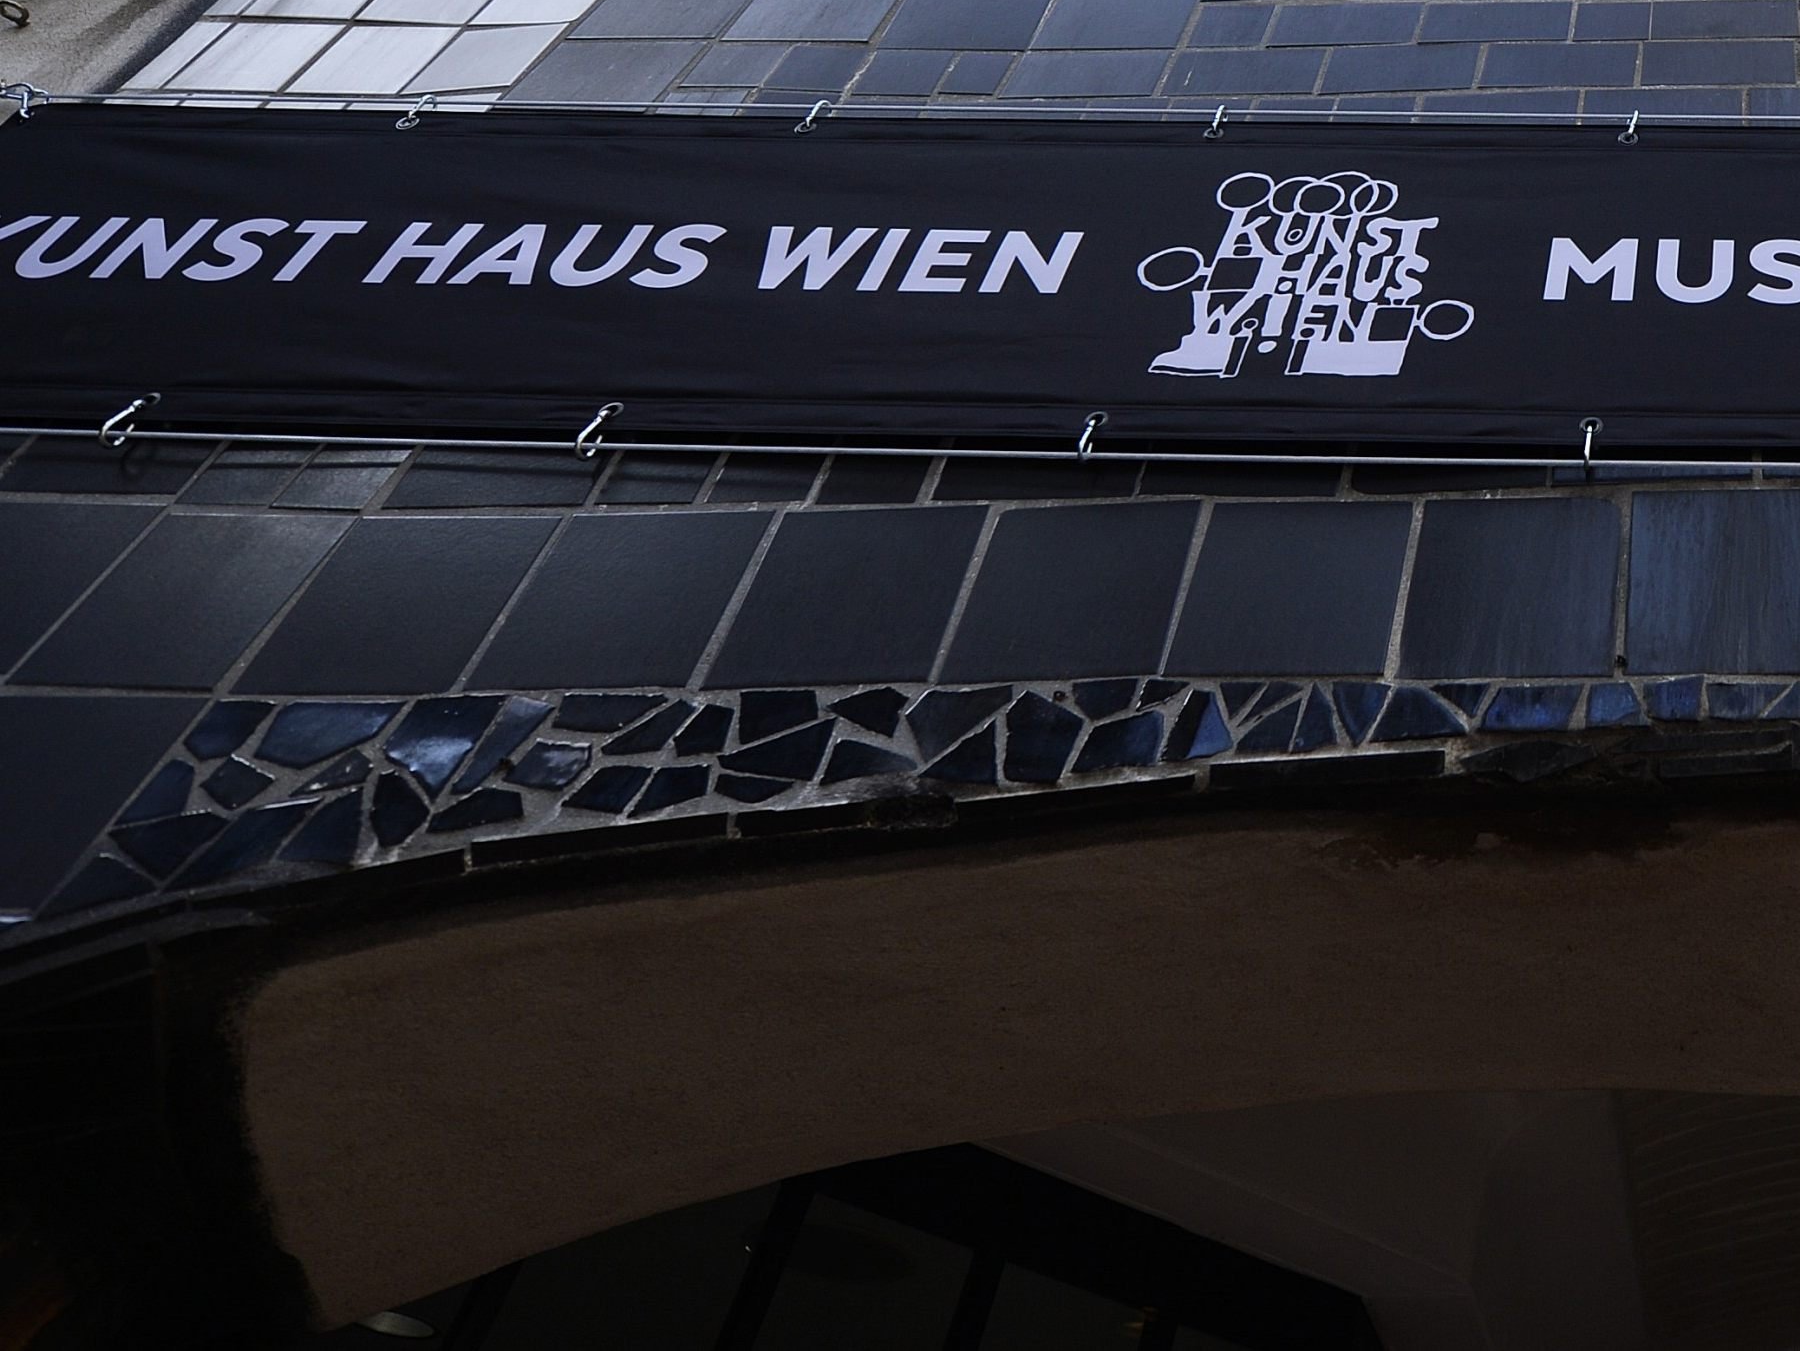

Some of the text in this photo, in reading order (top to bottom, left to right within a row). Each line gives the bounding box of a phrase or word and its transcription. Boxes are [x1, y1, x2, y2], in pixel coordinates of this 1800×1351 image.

[363, 222, 727, 289] HAUS
[759, 226, 1085, 294] WIEN
[1216, 206, 1439, 259] KUNST
[1250, 251, 1430, 302] HAUS
